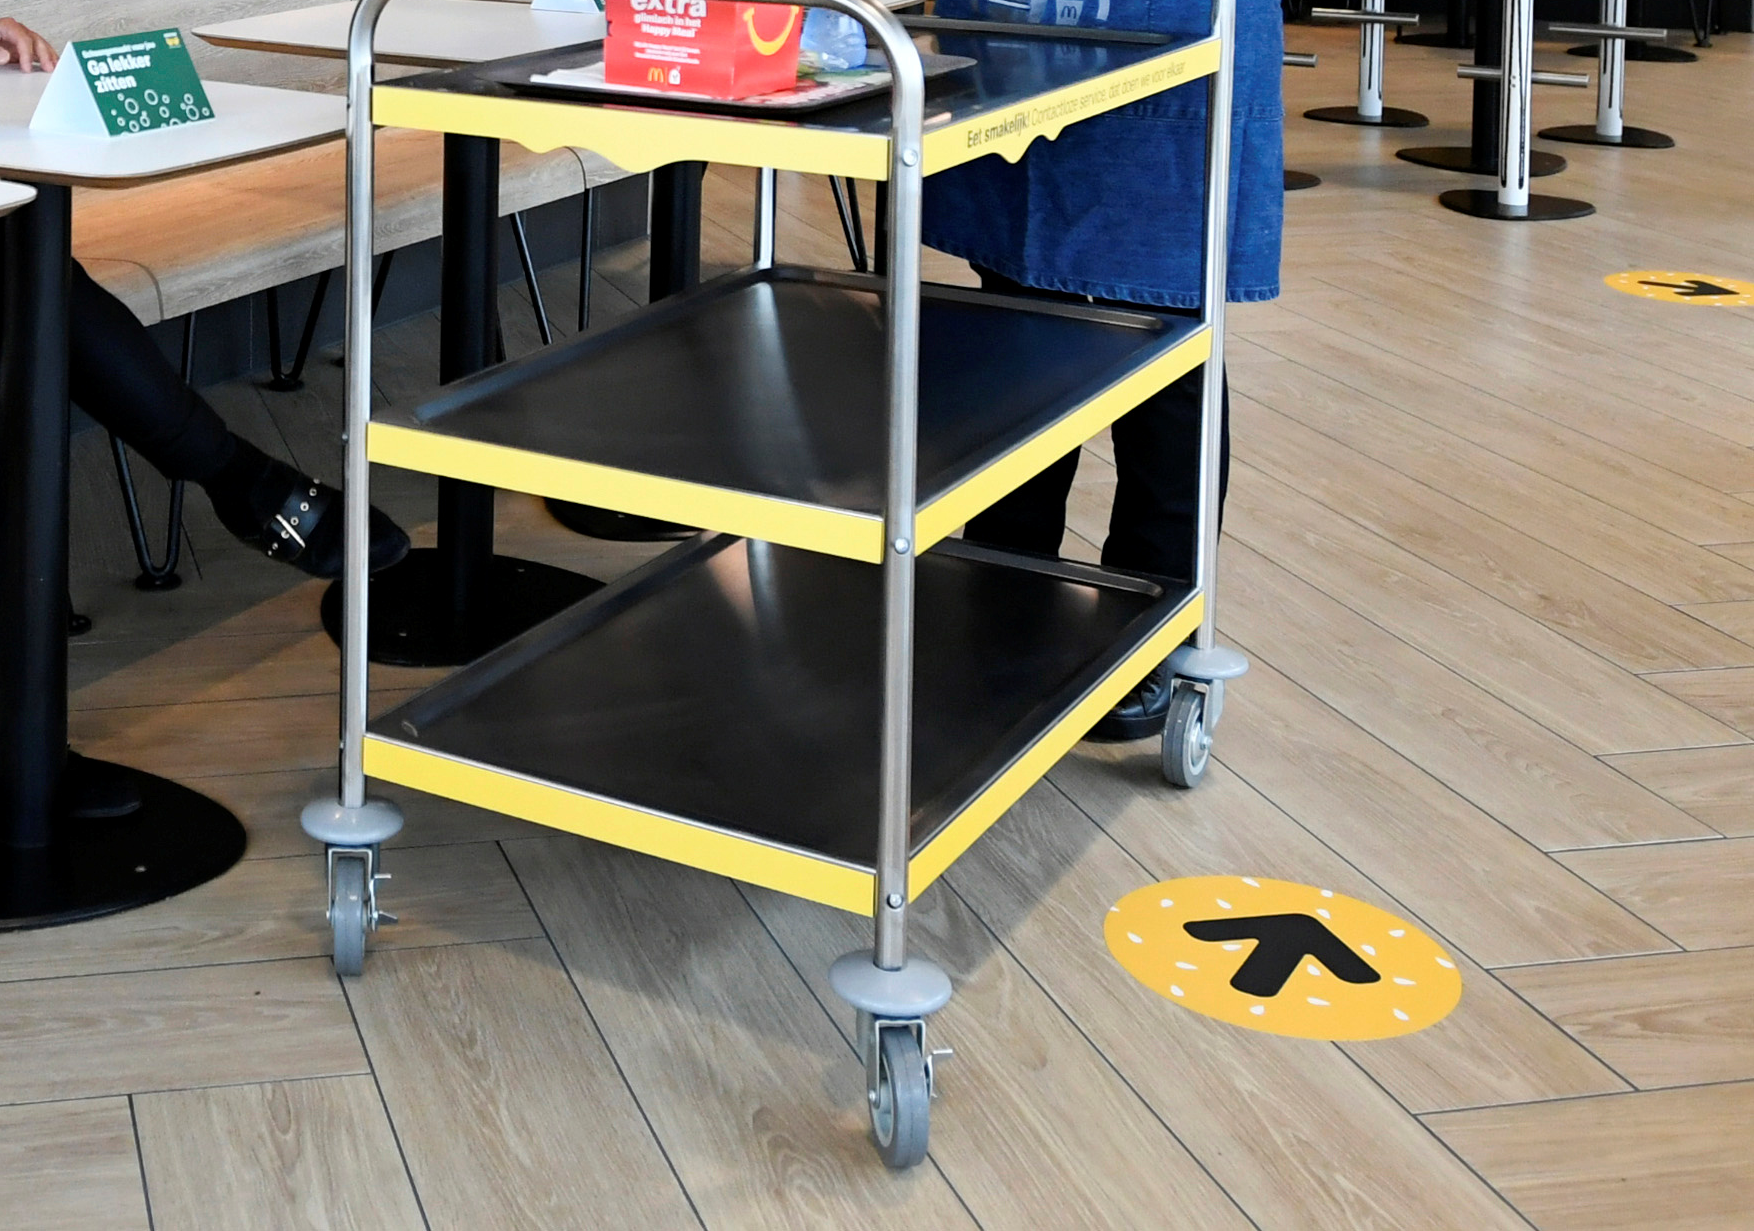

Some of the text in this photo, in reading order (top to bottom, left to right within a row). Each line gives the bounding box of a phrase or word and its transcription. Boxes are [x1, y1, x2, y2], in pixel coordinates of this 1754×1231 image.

[634, 12, 701, 28] glimlach in het
[641, 23, 671, 37] Happy
[87, 54, 151, 76] Ga lekker
[94, 75, 137, 93] zitten
[967, 129, 983, 149] Eet
[984, 110, 1030, 143] smakelijk!
[1031, 97, 1079, 127] Contactloze
[1108, 81, 1121, 100] dat
[1121, 78, 1139, 94] doen
[1140, 75, 1150, 88] we
[1151, 68, 1166, 84] voor
[1166, 60, 1186, 79] elkaar
